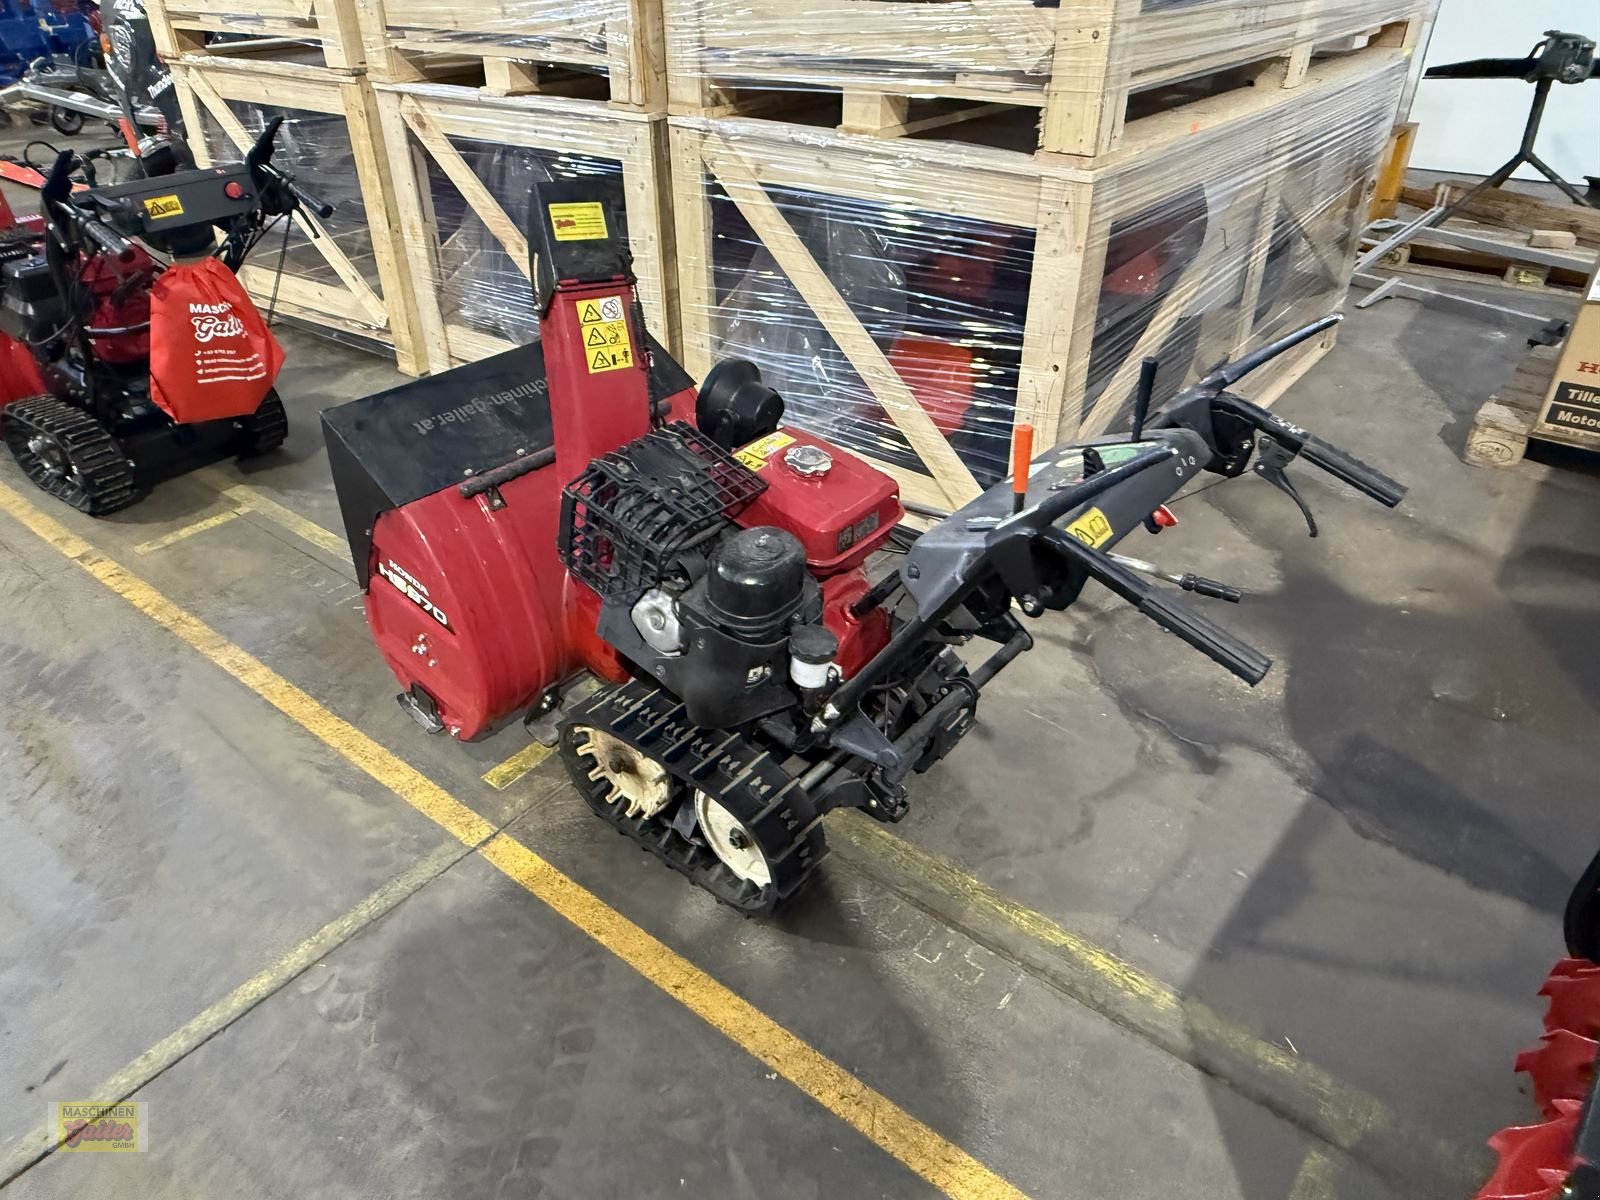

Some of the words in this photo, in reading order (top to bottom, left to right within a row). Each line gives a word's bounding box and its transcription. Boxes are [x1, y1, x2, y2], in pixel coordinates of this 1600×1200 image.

[1577, 361, 1600, 374] H
[412, 378, 548, 435] chinen-gailer.at
[388, 559, 430, 597] HONDA
